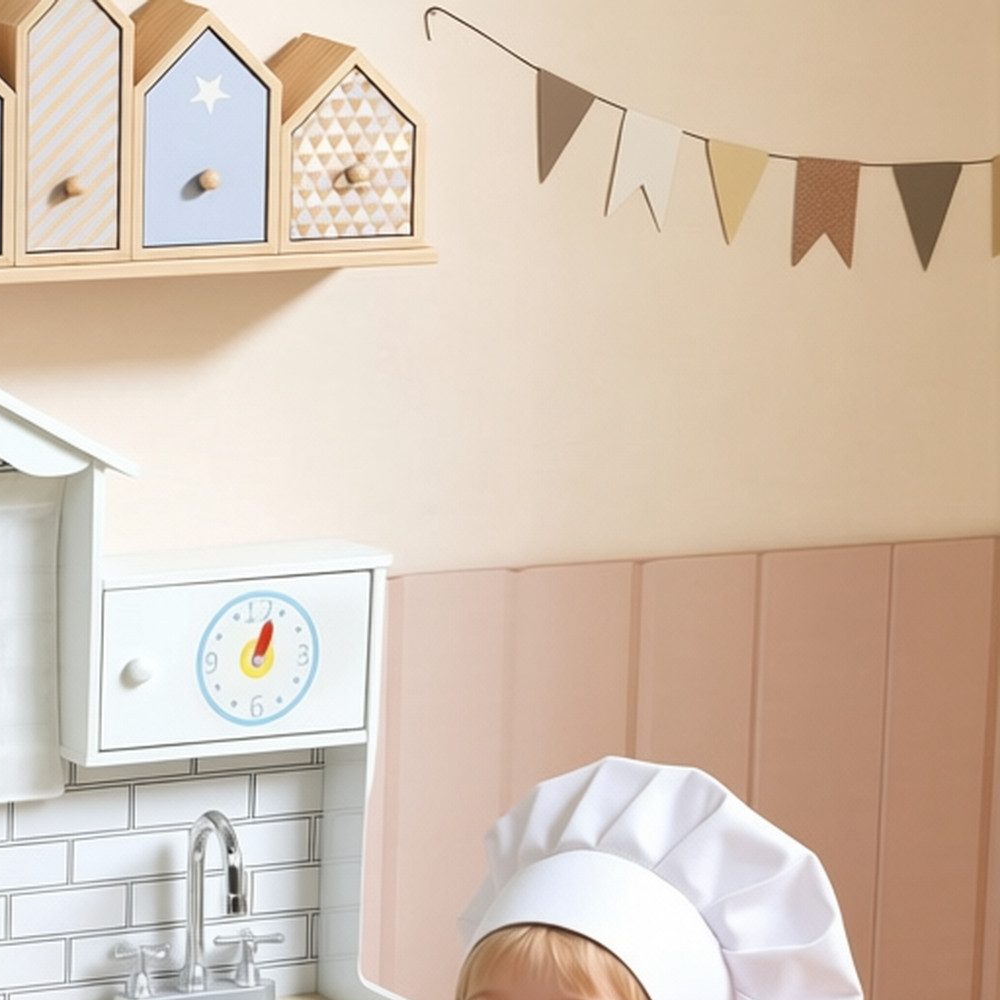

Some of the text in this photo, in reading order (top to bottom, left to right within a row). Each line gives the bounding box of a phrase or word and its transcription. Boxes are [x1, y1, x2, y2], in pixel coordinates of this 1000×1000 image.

[205, 651, 218, 674] 9
[298, 644, 309, 666] 3
[250, 695, 263, 718] 6
